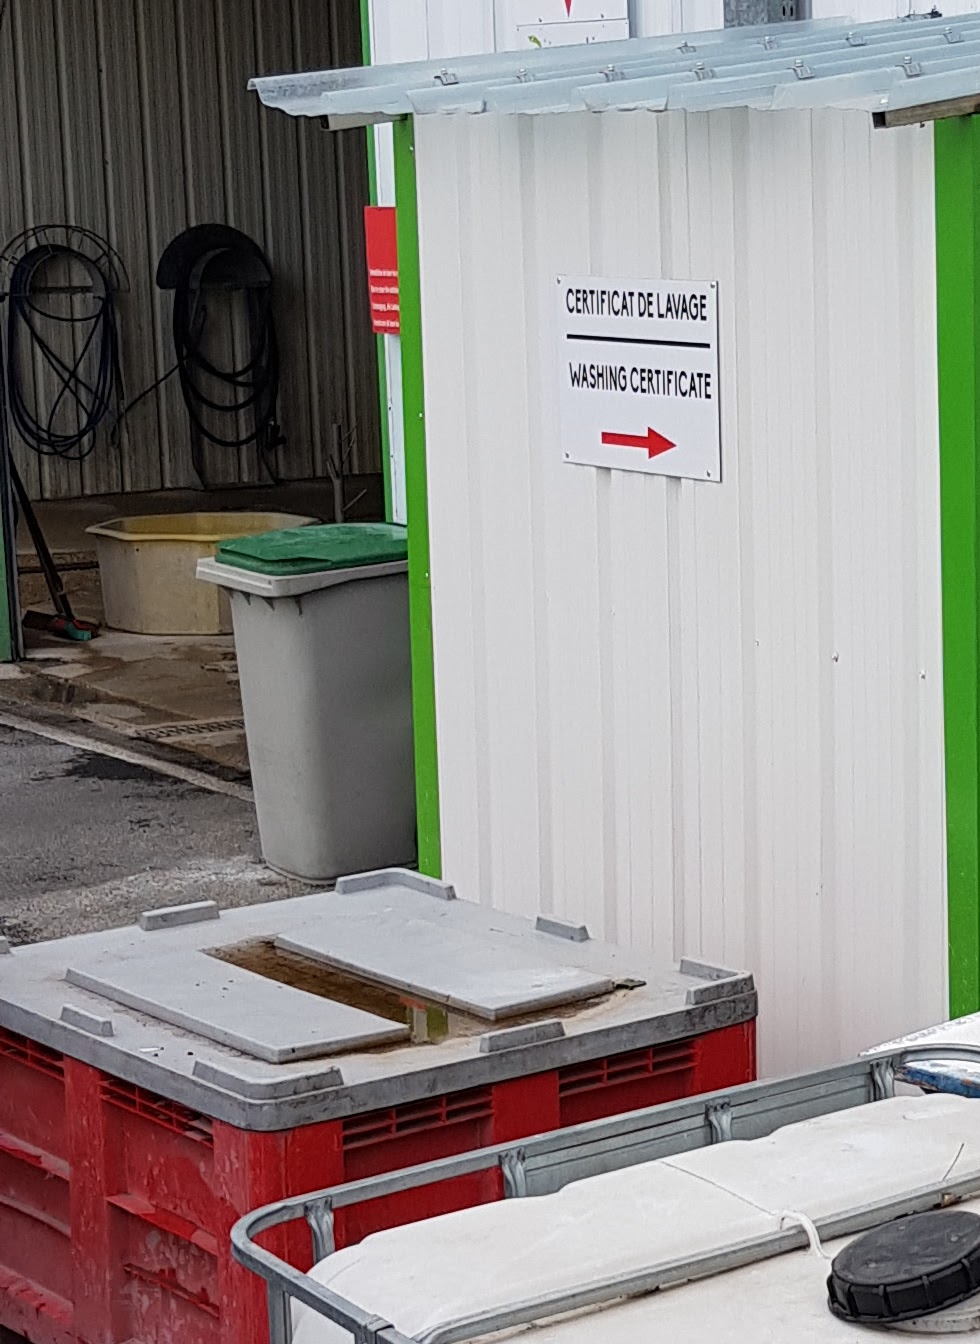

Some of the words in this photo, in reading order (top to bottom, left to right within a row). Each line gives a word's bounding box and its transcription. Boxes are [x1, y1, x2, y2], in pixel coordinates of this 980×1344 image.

[566, 288, 635, 317] CERTIFICAT
[638, 292, 654, 318] DE
[657, 293, 707, 321] LAVAGE
[569, 362, 627, 392] WASHING
[630, 367, 712, 399] CERTIFICATE
